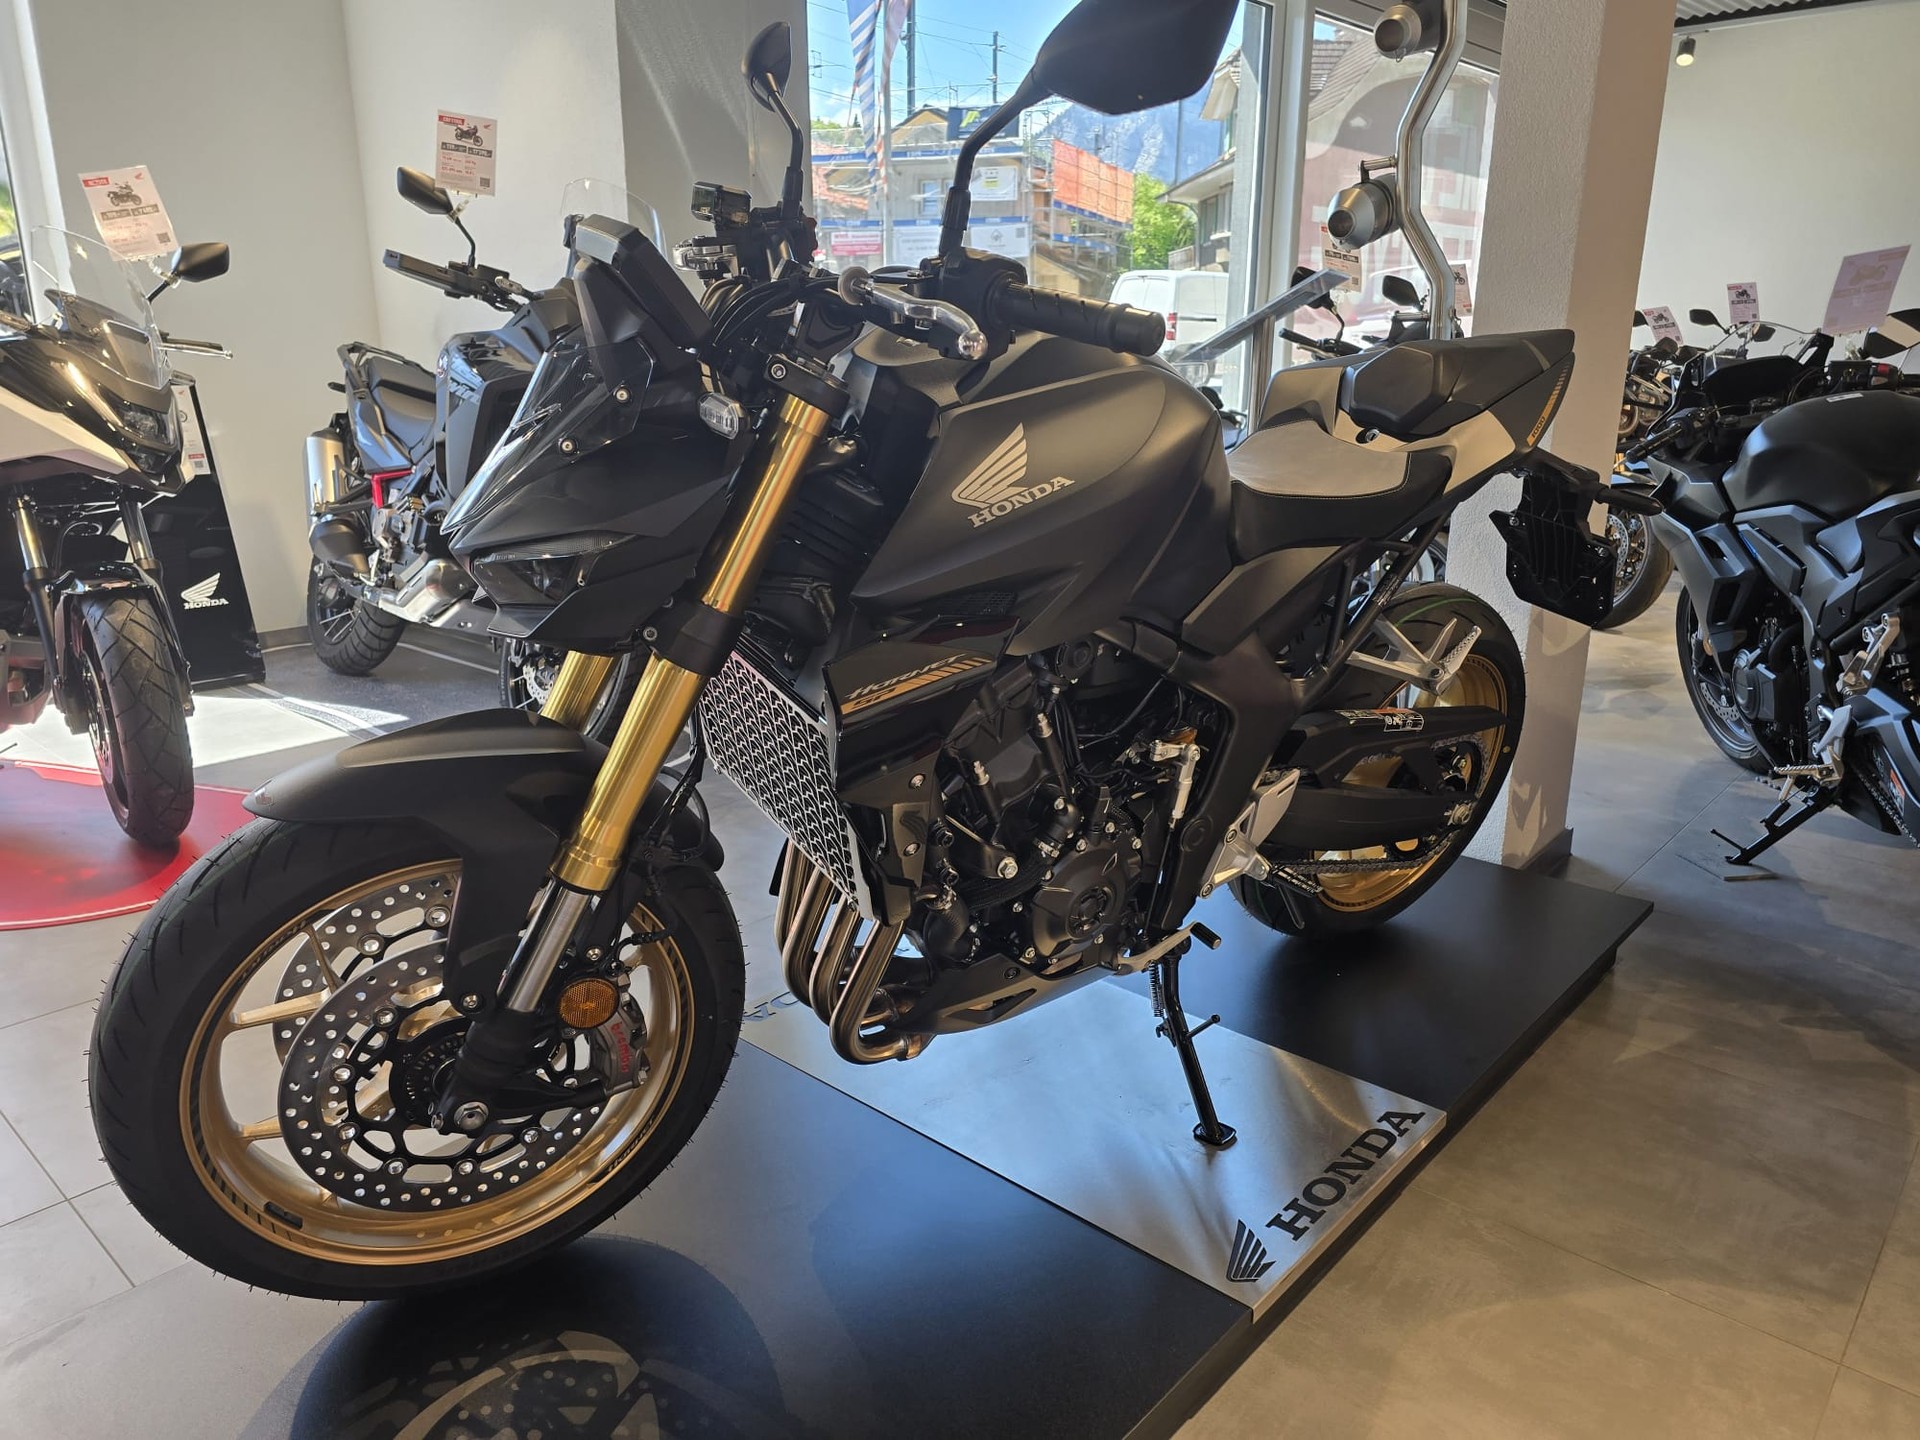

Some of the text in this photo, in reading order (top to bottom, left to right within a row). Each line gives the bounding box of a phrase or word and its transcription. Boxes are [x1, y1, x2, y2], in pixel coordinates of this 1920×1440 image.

[967, 476, 1076, 528] HONDA
[183, 598, 230, 610] HONDA
[844, 653, 967, 699] HORNET
[610, 1021, 632, 1073] brembo
[1265, 1110, 1426, 1242] HONDA
